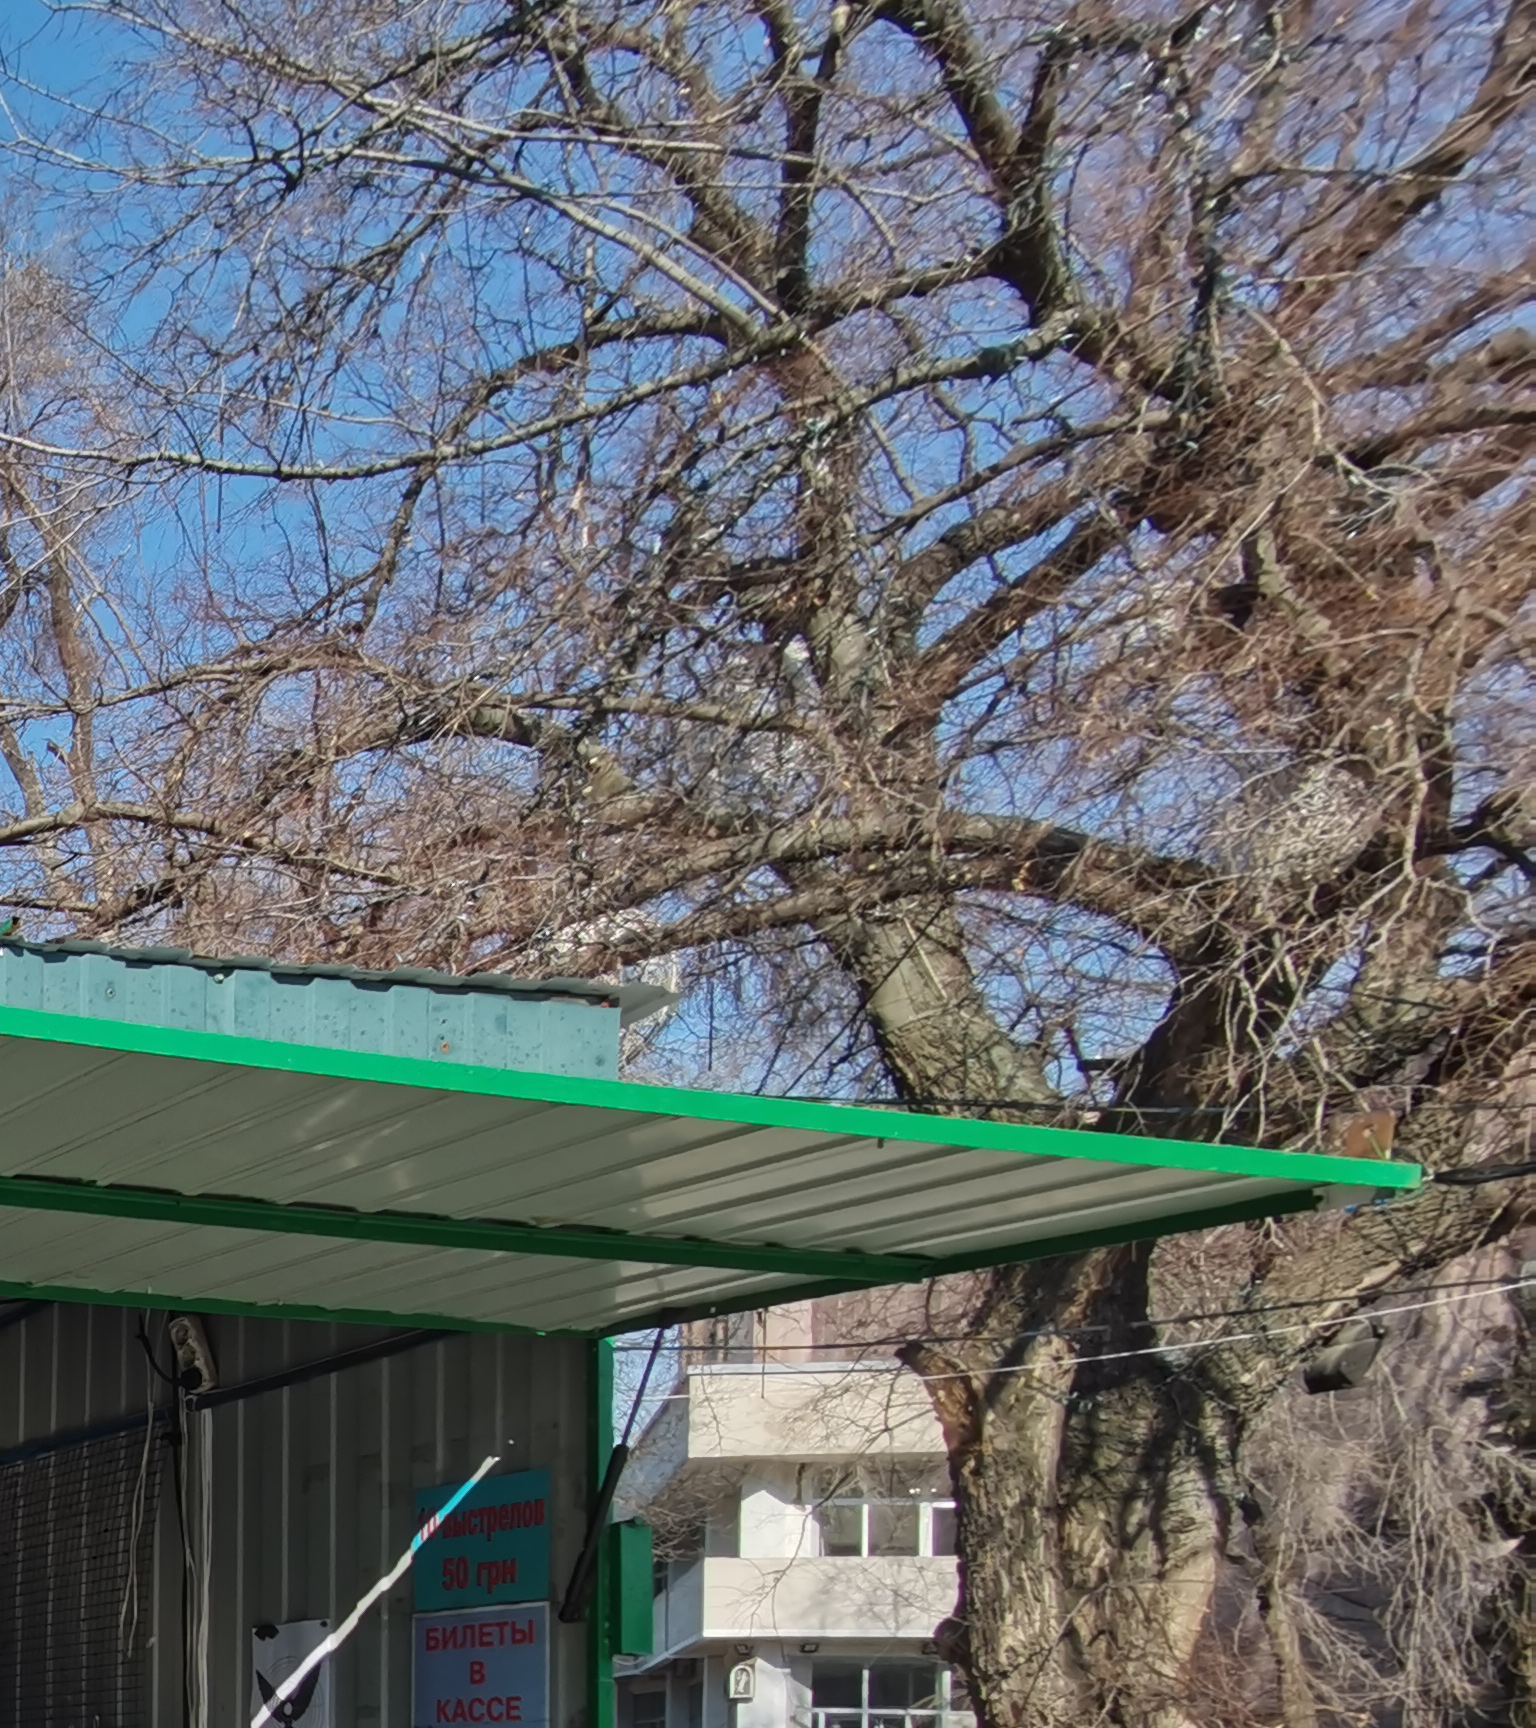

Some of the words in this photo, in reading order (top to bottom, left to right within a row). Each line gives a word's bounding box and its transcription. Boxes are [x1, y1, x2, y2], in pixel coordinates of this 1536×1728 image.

[442, 1556, 470, 1590] 50
[476, 1558, 517, 1594] грн
[425, 1619, 534, 1652] БИЛЕТЫ
[469, 1661, 486, 1685] В
[436, 1696, 522, 1723] КАССЕ
